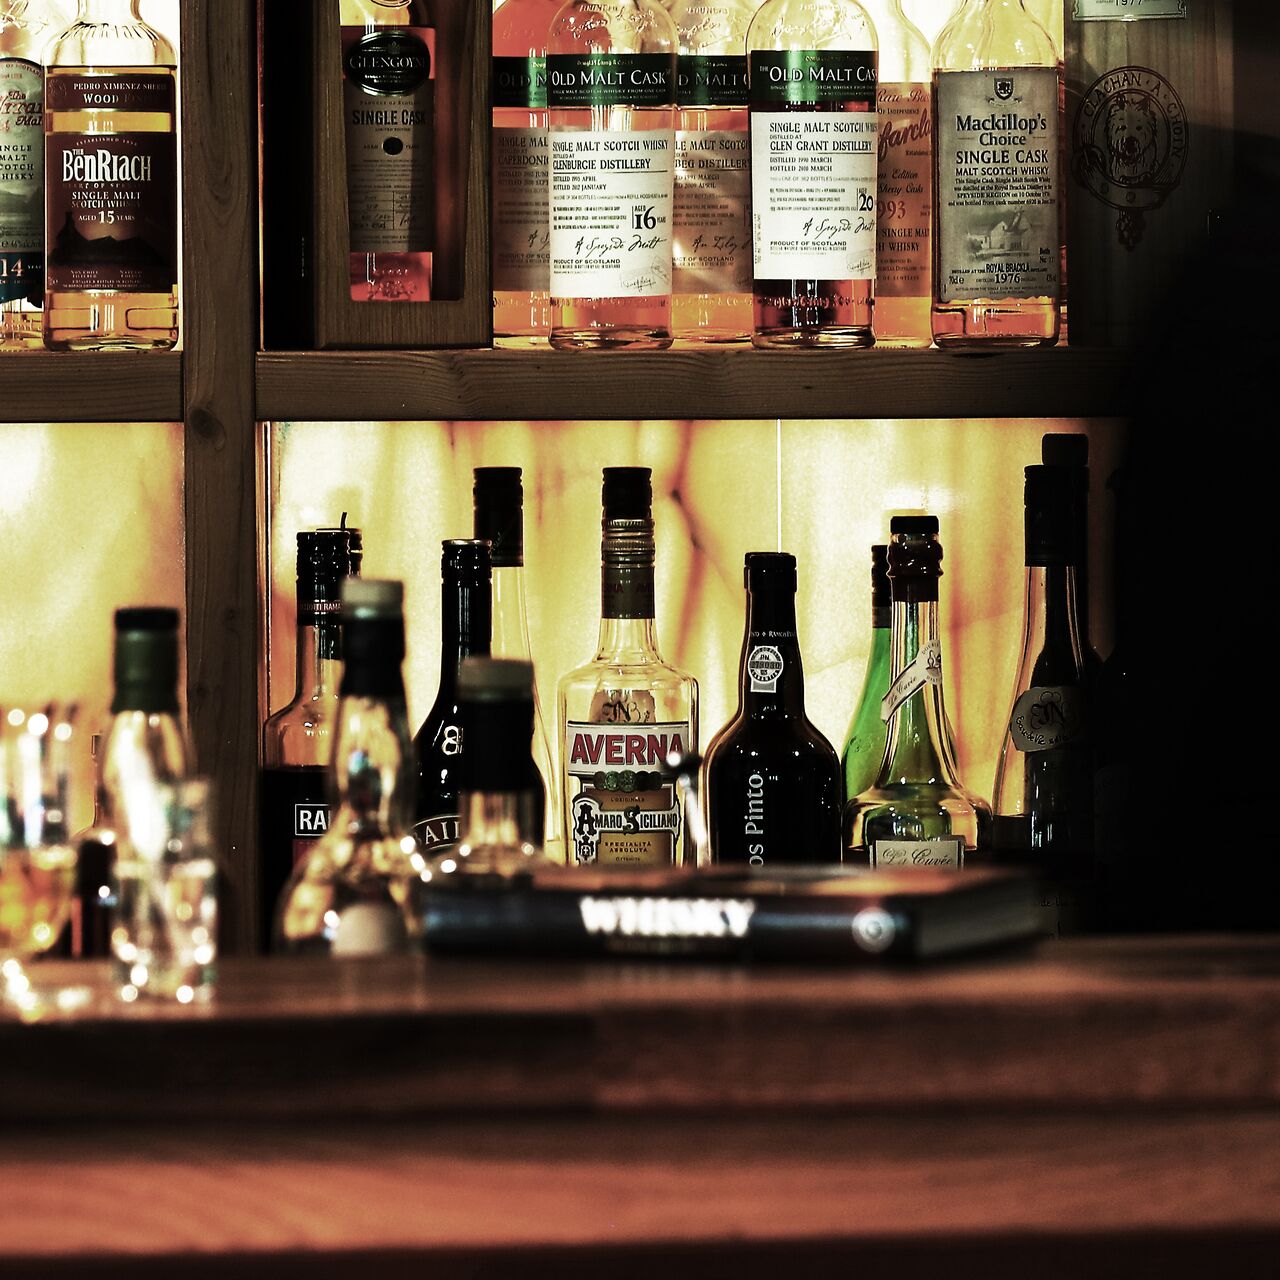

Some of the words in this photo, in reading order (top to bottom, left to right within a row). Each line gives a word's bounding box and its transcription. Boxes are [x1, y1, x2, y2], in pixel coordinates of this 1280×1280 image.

[552, 71, 575, 85] OLD
[581, 70, 627, 85] MALT
[631, 71, 665, 84] CASK
[770, 66, 804, 82] OLD
[809, 66, 852, 81] MALT
[102, 82, 139, 90] XIMENEZ
[83, 94, 119, 103] WOOD
[353, 109, 397, 125] SINGLE
[957, 114, 1046, 134] Mackillop's
[770, 123, 800, 132] SINGLE
[804, 123, 831, 132] MALT
[834, 123, 864, 132] SCOTCH
[576, 142, 600, 151] MALT
[604, 141, 640, 151] SCOTCH
[643, 140, 668, 150] WHISKY
[980, 132, 1026, 145] Choice
[770, 141, 792, 151] GLEN
[796, 141, 827, 150] GRANT
[832, 141, 871, 150] DISTILLERY
[956, 151, 1009, 164] SINGLE
[1016, 150, 1048, 163] CASK
[553, 161, 597, 170] GLENBURGIE
[600, 159, 651, 170] DISTILLERY
[1021, 167, 1048, 175] WHISKY
[72, 192, 109, 200] SINGLE
[114, 192, 140, 200] MALT
[98, 211, 115, 225] 15
[635, 207, 656, 229] 16
[0, 260, 22, 277] 14
[995, 274, 1019, 284] 1976
[571, 734, 683, 765] AVERNA
[745, 774, 764, 834] Pinto
[577, 803, 622, 835] AMARO
[623, 806, 677, 835] SICILIANO
